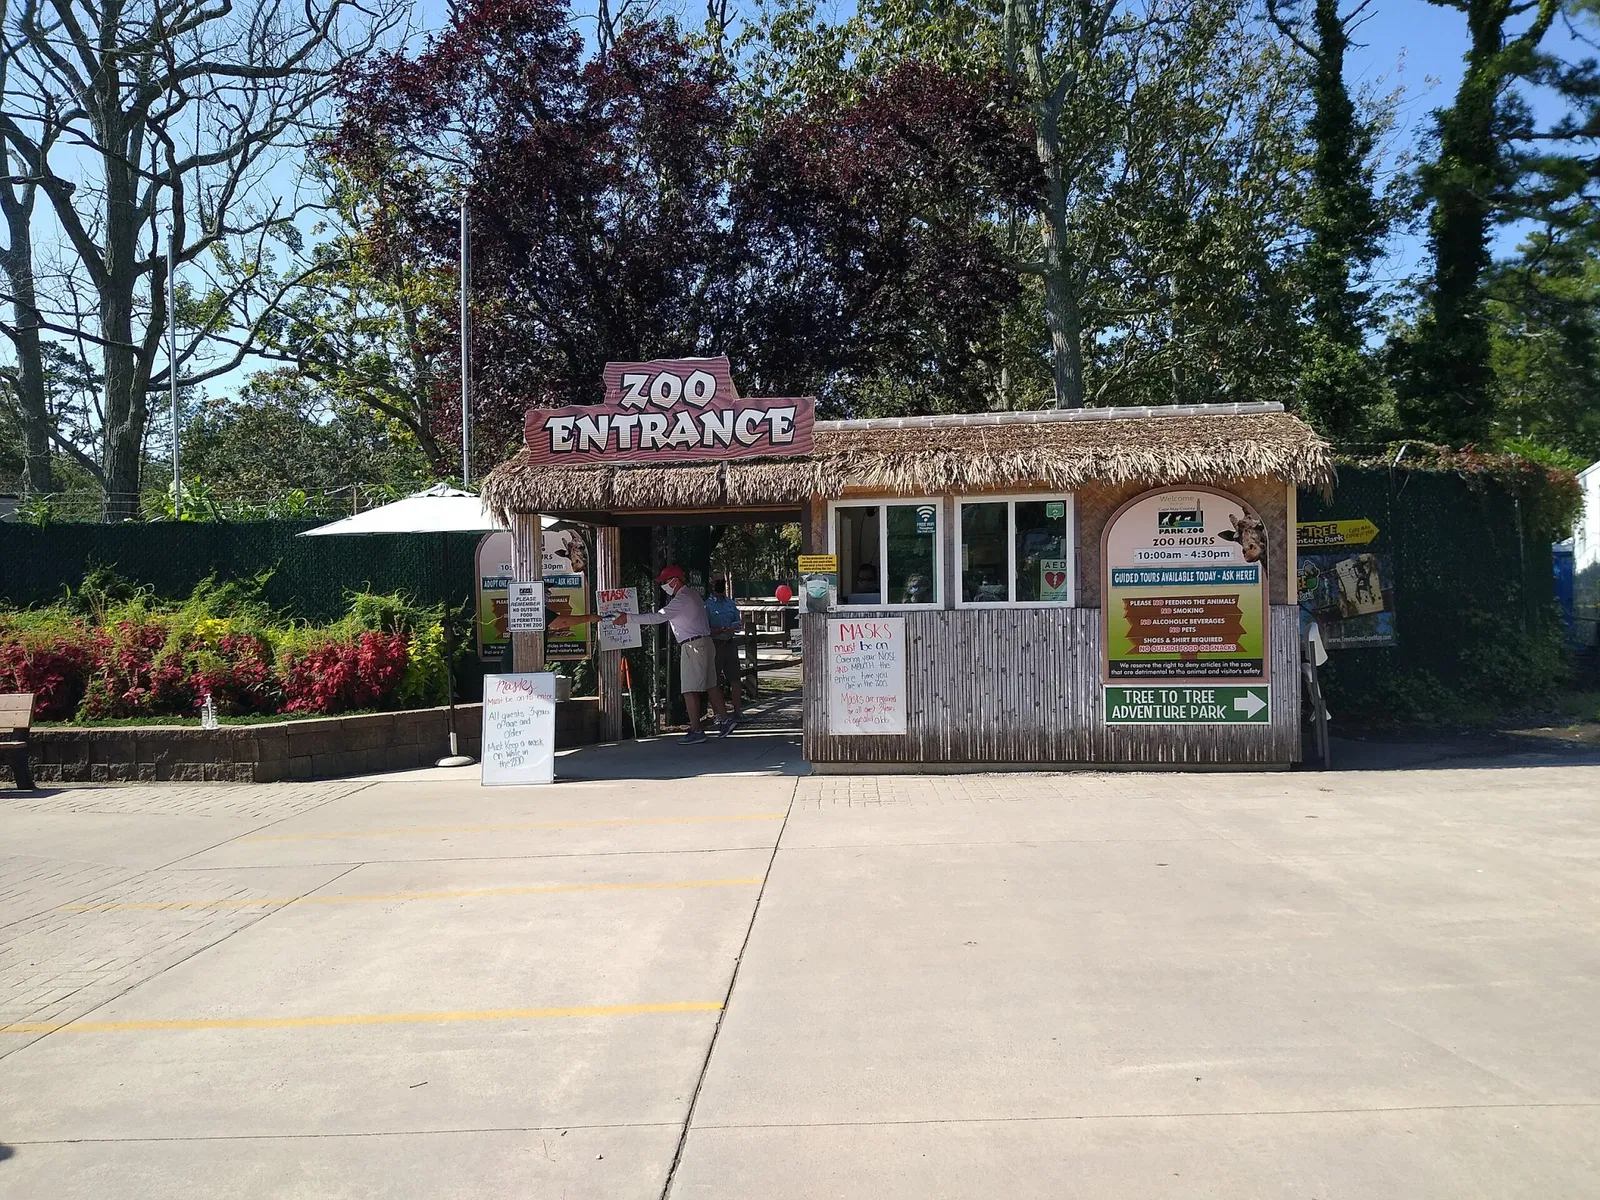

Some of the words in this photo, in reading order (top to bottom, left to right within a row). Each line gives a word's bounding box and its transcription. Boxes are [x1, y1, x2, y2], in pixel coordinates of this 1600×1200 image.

[618, 369, 717, 412] ZOO
[543, 405, 797, 453] ENTRANCE
[1304, 524, 1338, 538] TREE
[1153, 538, 1175, 546] ZOO
[1179, 536, 1215, 545] HOURS
[1324, 534, 1344, 544] Park
[1138, 551, 1182, 559] 10:00am
[1190, 550, 1230, 560] 4:30pm
[1114, 572, 1139, 583] GUIDED
[1140, 572, 1160, 582] TOURS
[1161, 570, 1194, 582] AVAILABLE
[1196, 570, 1216, 581] TODAY
[1222, 570, 1234, 580] ASK
[1236, 569, 1256, 580] HERE!
[840, 622, 892, 642] MASKS
[834, 642, 856, 652] must
[860, 641, 872, 651] be
[876, 642, 888, 650] on
[836, 654, 860, 664] Covering
[878, 651, 896, 661] NOSE
[851, 662, 874, 670] MOUTH
[835, 674, 856, 683] entire
[876, 672, 888, 680] you
[841, 693, 864, 704] Masks
[1123, 690, 1154, 704] TREE
[1159, 690, 1178, 704] TO
[1183, 689, 1215, 704] TREE
[489, 711, 500, 721] All
[502, 710, 524, 719] guests
[1112, 705, 1186, 719] ADVENTURE
[1190, 705, 1227, 719] PARK
[488, 741, 502, 752] Must
[528, 738, 544, 746] mask
